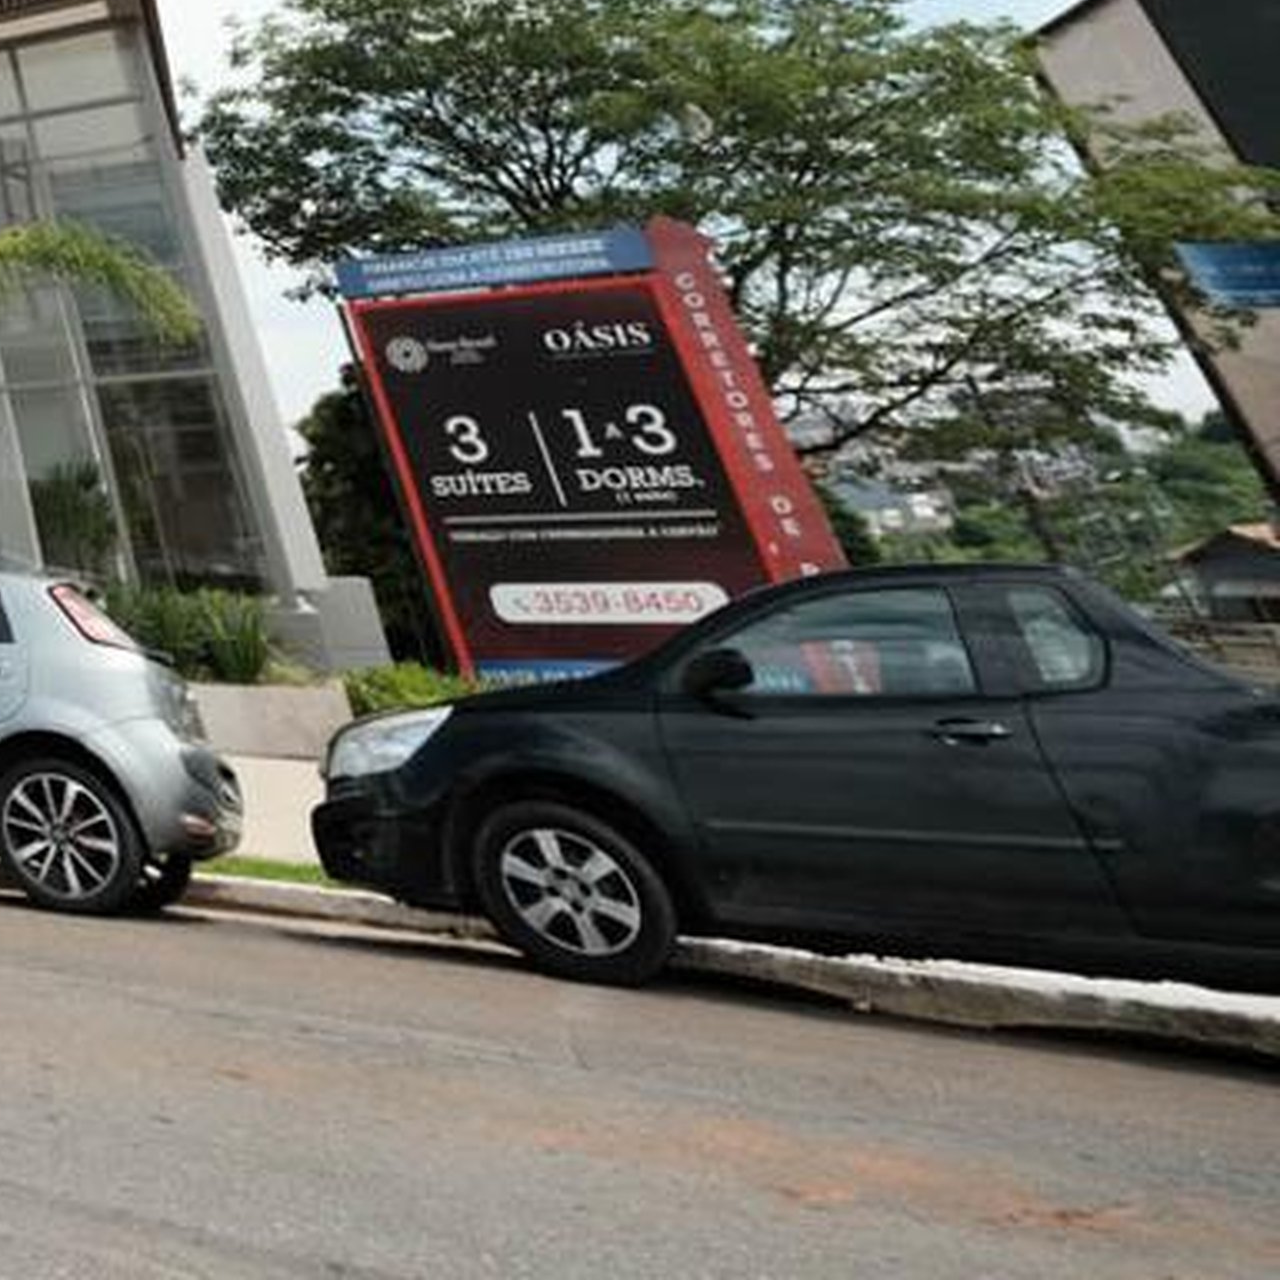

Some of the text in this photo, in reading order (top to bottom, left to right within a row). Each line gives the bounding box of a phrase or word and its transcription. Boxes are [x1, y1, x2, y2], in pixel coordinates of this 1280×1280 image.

[543, 320, 652, 352] OÁSIS
[675, 272, 774, 471] CORRETORES
[445, 415, 489, 463] 3
[561, 408, 603, 458] 1
[625, 403, 677, 455] 3
[429, 470, 533, 497] SUÍTES
[575, 464, 705, 492] DORMS.
